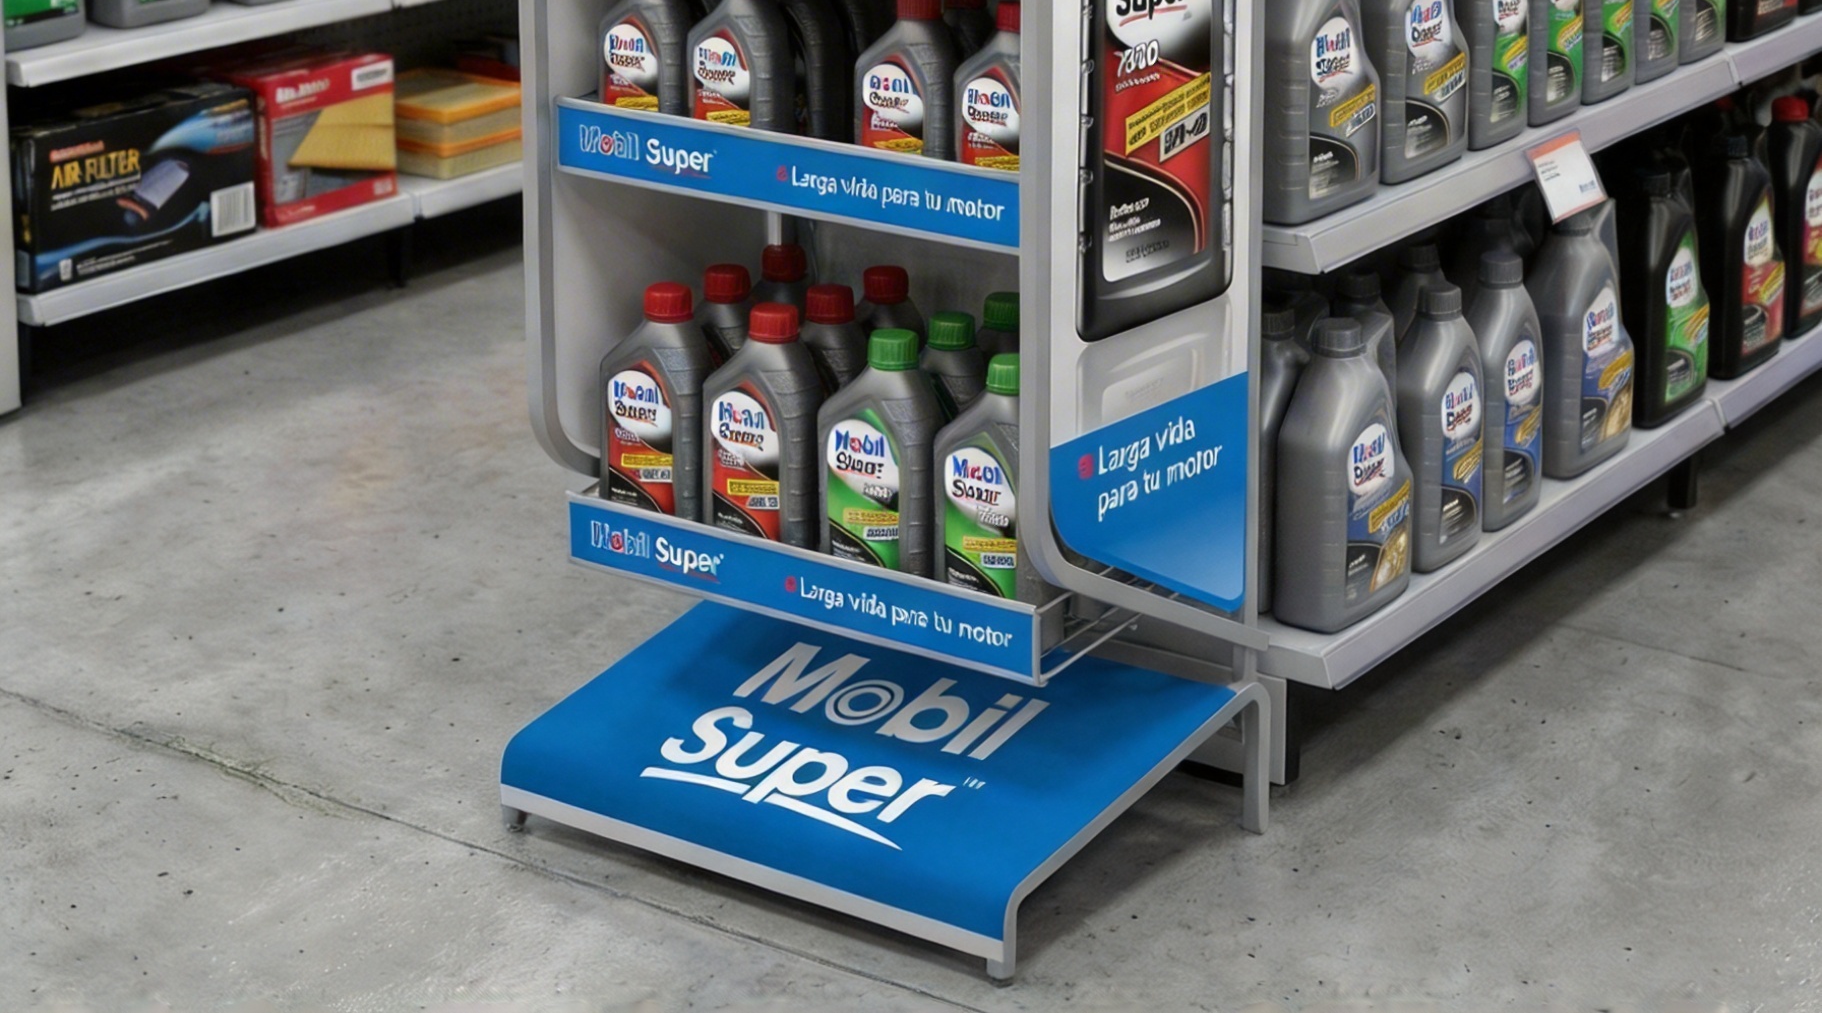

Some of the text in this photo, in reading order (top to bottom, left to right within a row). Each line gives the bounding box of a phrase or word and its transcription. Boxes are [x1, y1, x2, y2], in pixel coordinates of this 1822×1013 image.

[52, 161, 83, 190] AIR
[646, 138, 714, 175] Super
[882, 186, 920, 209] para
[924, 189, 941, 211] tu
[946, 196, 1005, 221] motor
[1098, 416, 1196, 475] Larga vida
[1097, 482, 1138, 523] para
[1143, 469, 1160, 495] tu
[655, 536, 721, 576] Super
[800, 576, 844, 610] Larga
[848, 592, 887, 619] vida
[934, 610, 952, 634] tu
[733, 641, 1050, 761] Mobil
[660, 706, 957, 824] Super
